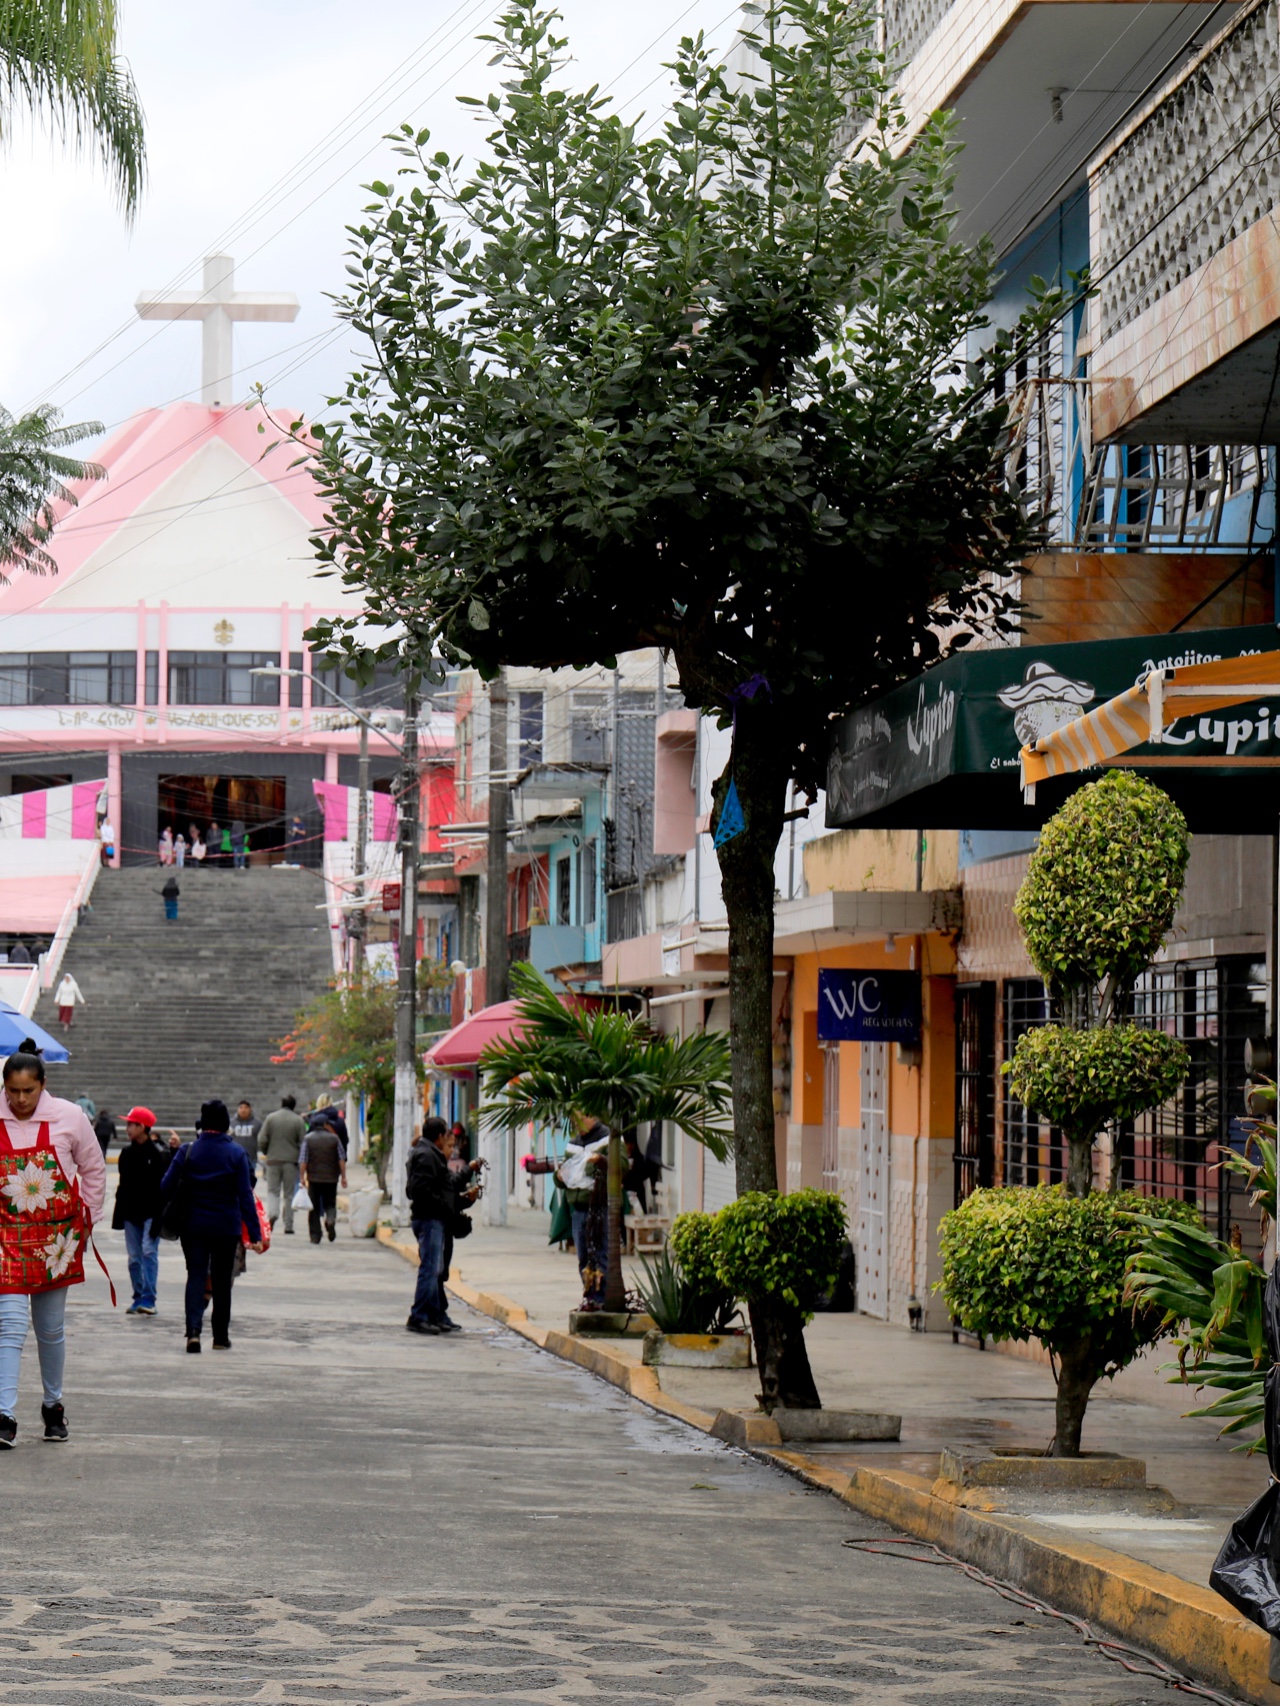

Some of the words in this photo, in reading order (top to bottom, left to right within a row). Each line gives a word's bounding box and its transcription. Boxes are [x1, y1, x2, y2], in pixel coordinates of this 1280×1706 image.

[907, 681, 955, 766] Lupita
[1162, 707, 1280, 755] Lupi
[1003, 757, 1021, 767] sabo
[823, 977, 881, 1020] WC
[862, 1017, 913, 1028] REGADERAS
[234, 1124, 255, 1137] CAT
